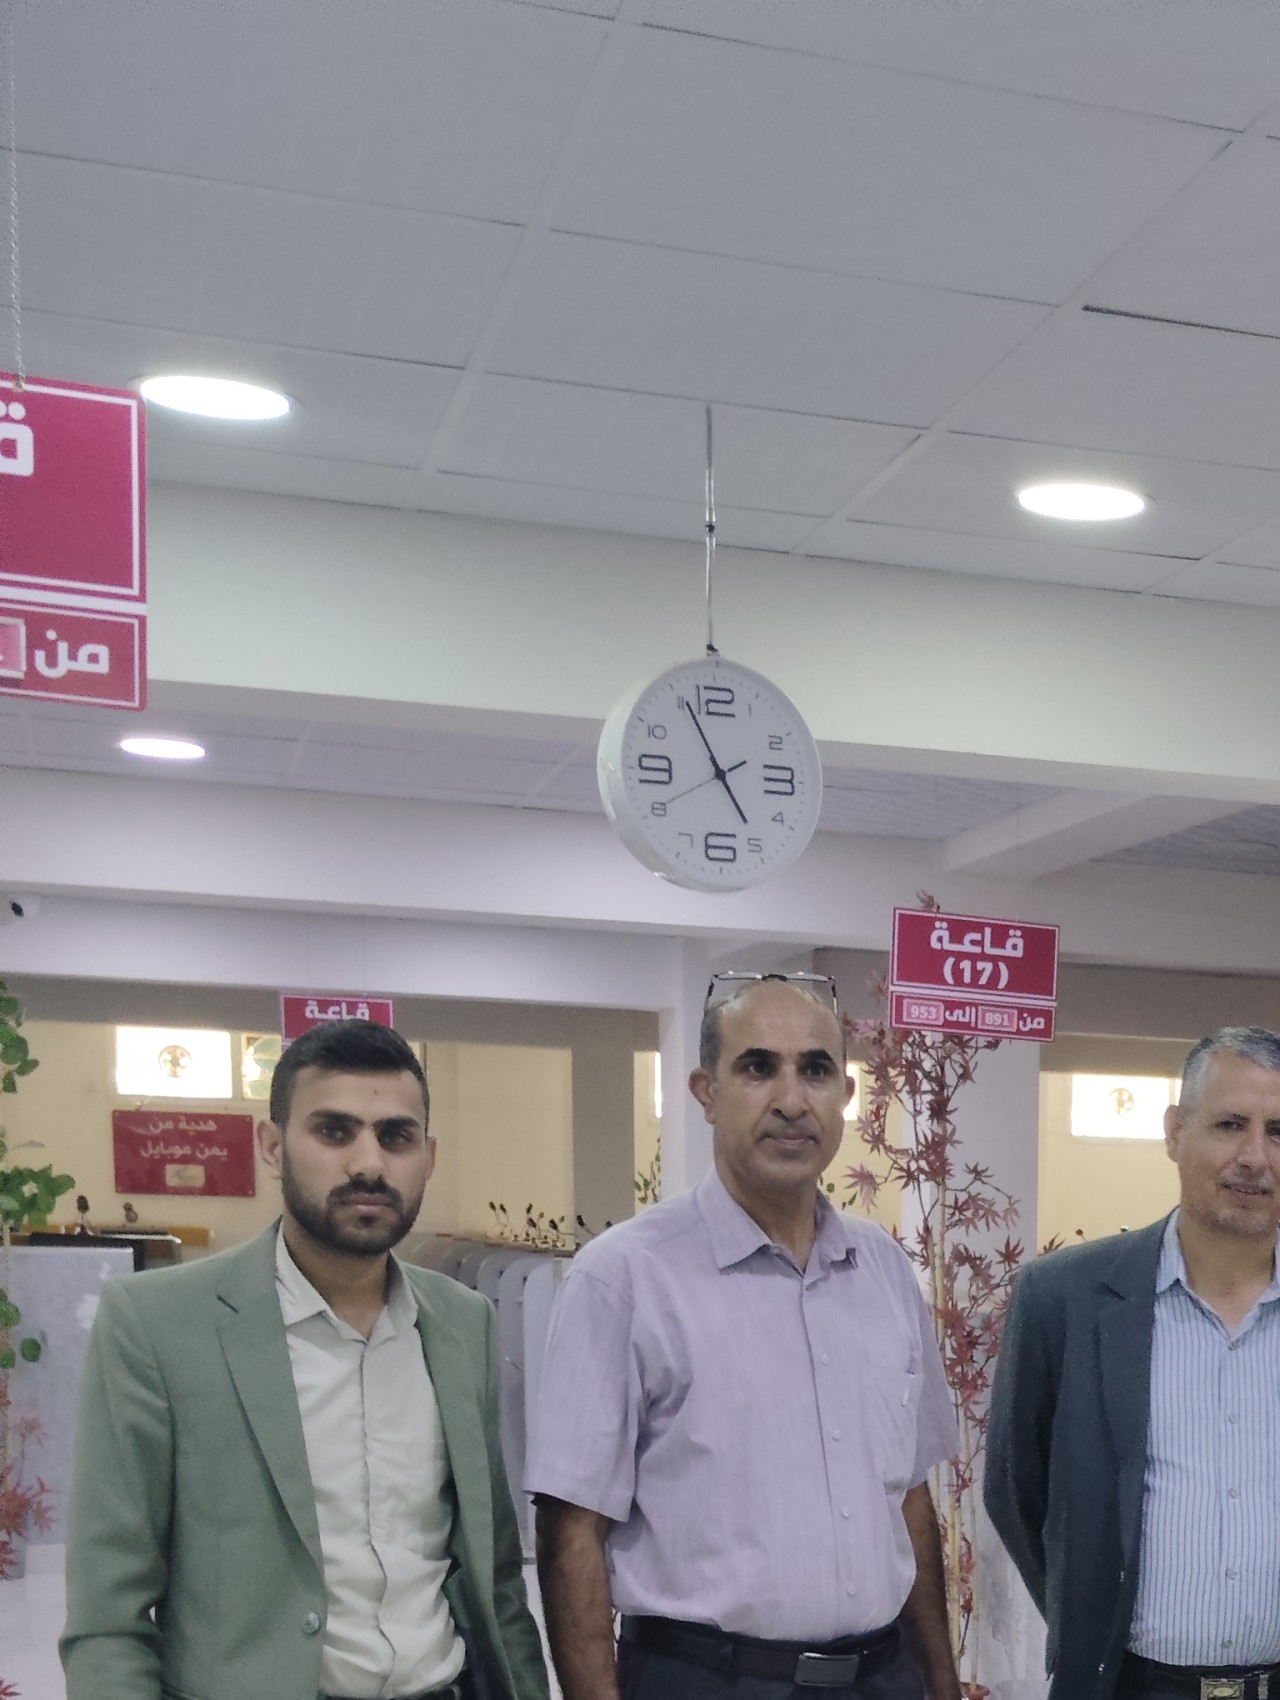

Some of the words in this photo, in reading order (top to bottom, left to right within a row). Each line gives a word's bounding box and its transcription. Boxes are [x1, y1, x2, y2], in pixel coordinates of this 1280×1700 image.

[34, 629, 110, 679] من
[695, 684, 736, 718] 12
[648, 724, 667, 740] 10
[768, 735, 783, 751] 2
[638, 753, 672, 786] 9
[763, 764, 795, 796] 3
[651, 801, 667, 817] 8
[771, 811, 785, 826] 4
[678, 832, 694, 848] 7
[704, 831, 737, 863] 6
[747, 838, 762, 853] 5
[930, 921, 1024, 958] قاعة
[943, 957, 1009, 989] (17)
[305, 1000, 369, 1020] قاعة
[910, 1005, 937, 1019] 953
[945, 1006, 977, 1027] إلى
[984, 1013, 1010, 1027] 891
[1019, 1013, 1045, 1032] من
[149, 1118, 175, 1134] من
[178, 1115, 218, 1135] هدية
[140, 1140, 192, 1159] موبايل
[195, 1143, 228, 1161] يمن
